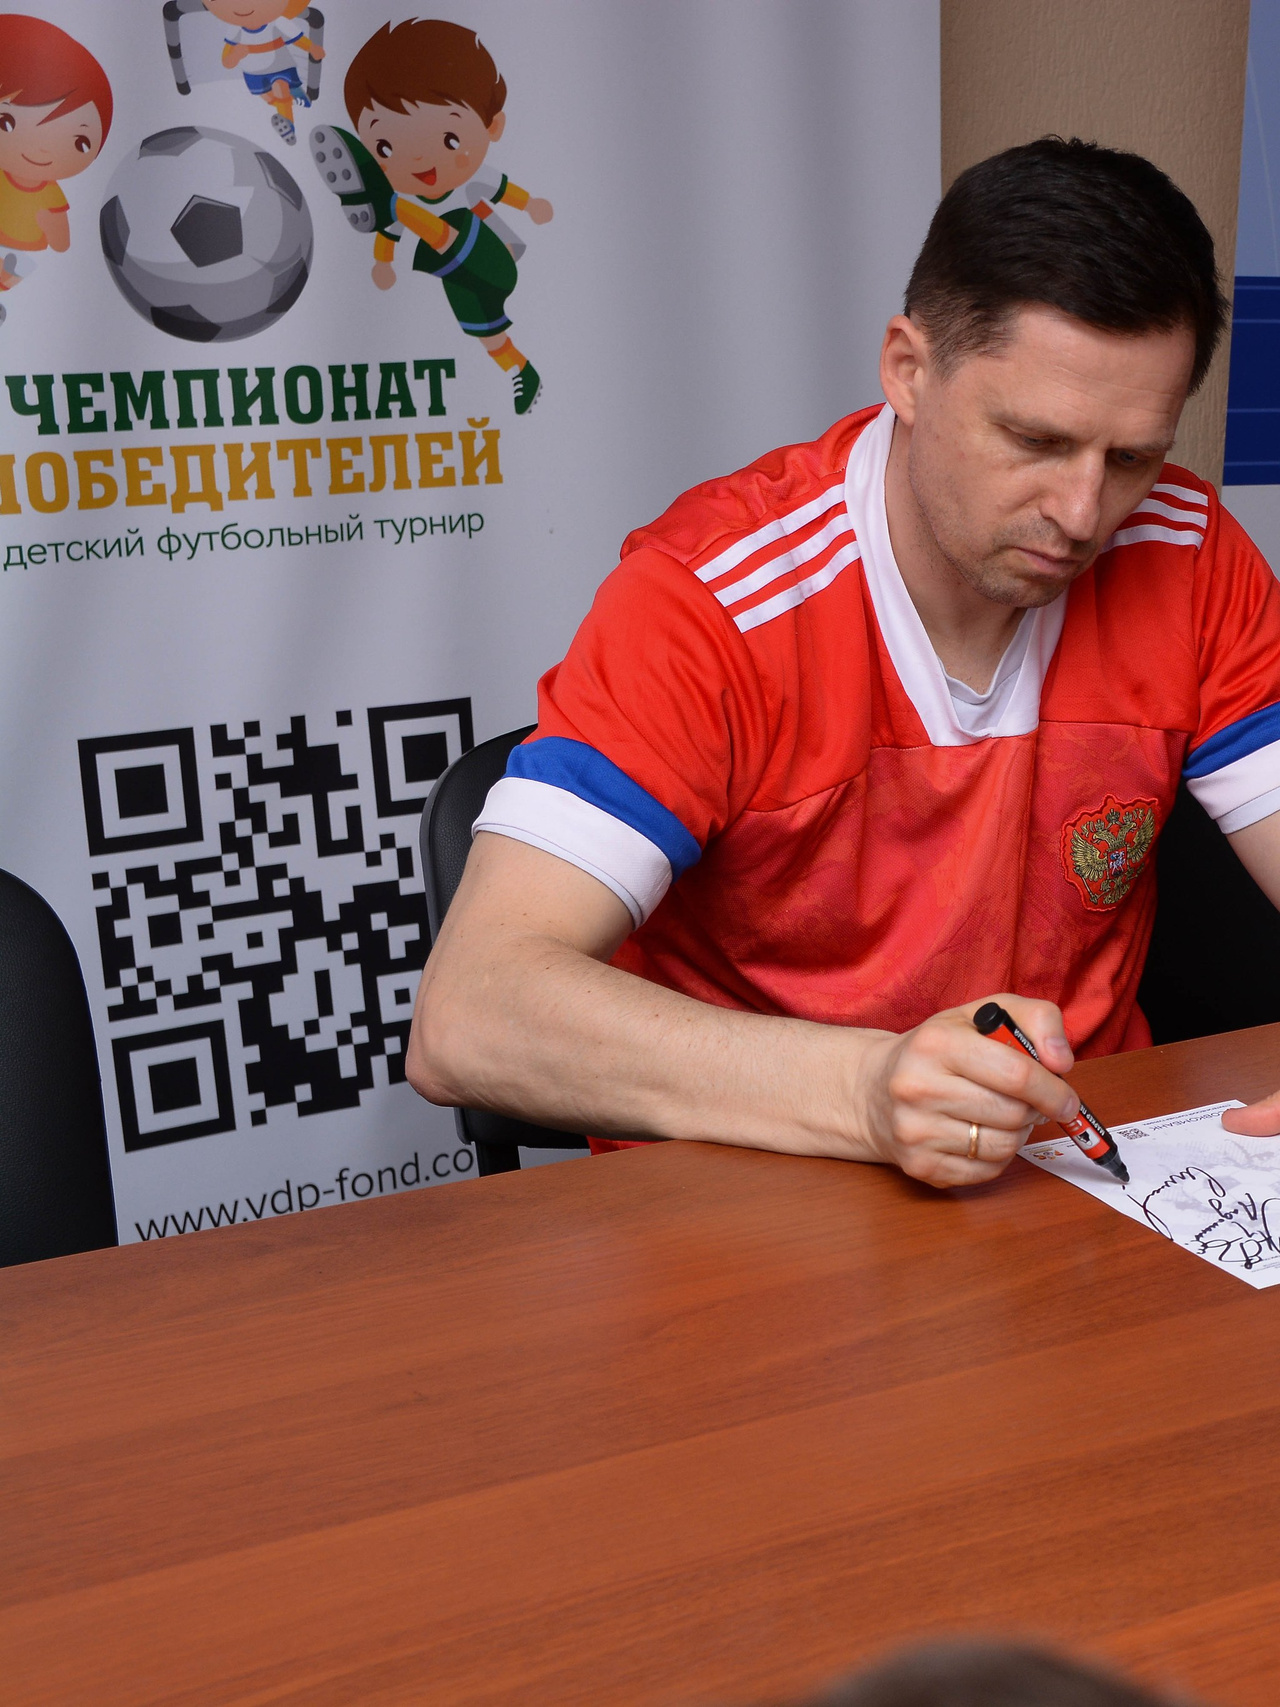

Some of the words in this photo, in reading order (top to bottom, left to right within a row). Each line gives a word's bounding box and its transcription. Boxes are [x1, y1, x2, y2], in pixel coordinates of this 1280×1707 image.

[5, 358, 456, 435] ЧЕМПИОНАТ
[3, 528, 145, 571] детский
[157, 514, 364, 561] футбольный
[373, 508, 485, 544] турнир
[1086, 1113, 1106, 1137] МАРКЕР
[135, 1148, 475, 1242] www.vdp-fond.co
